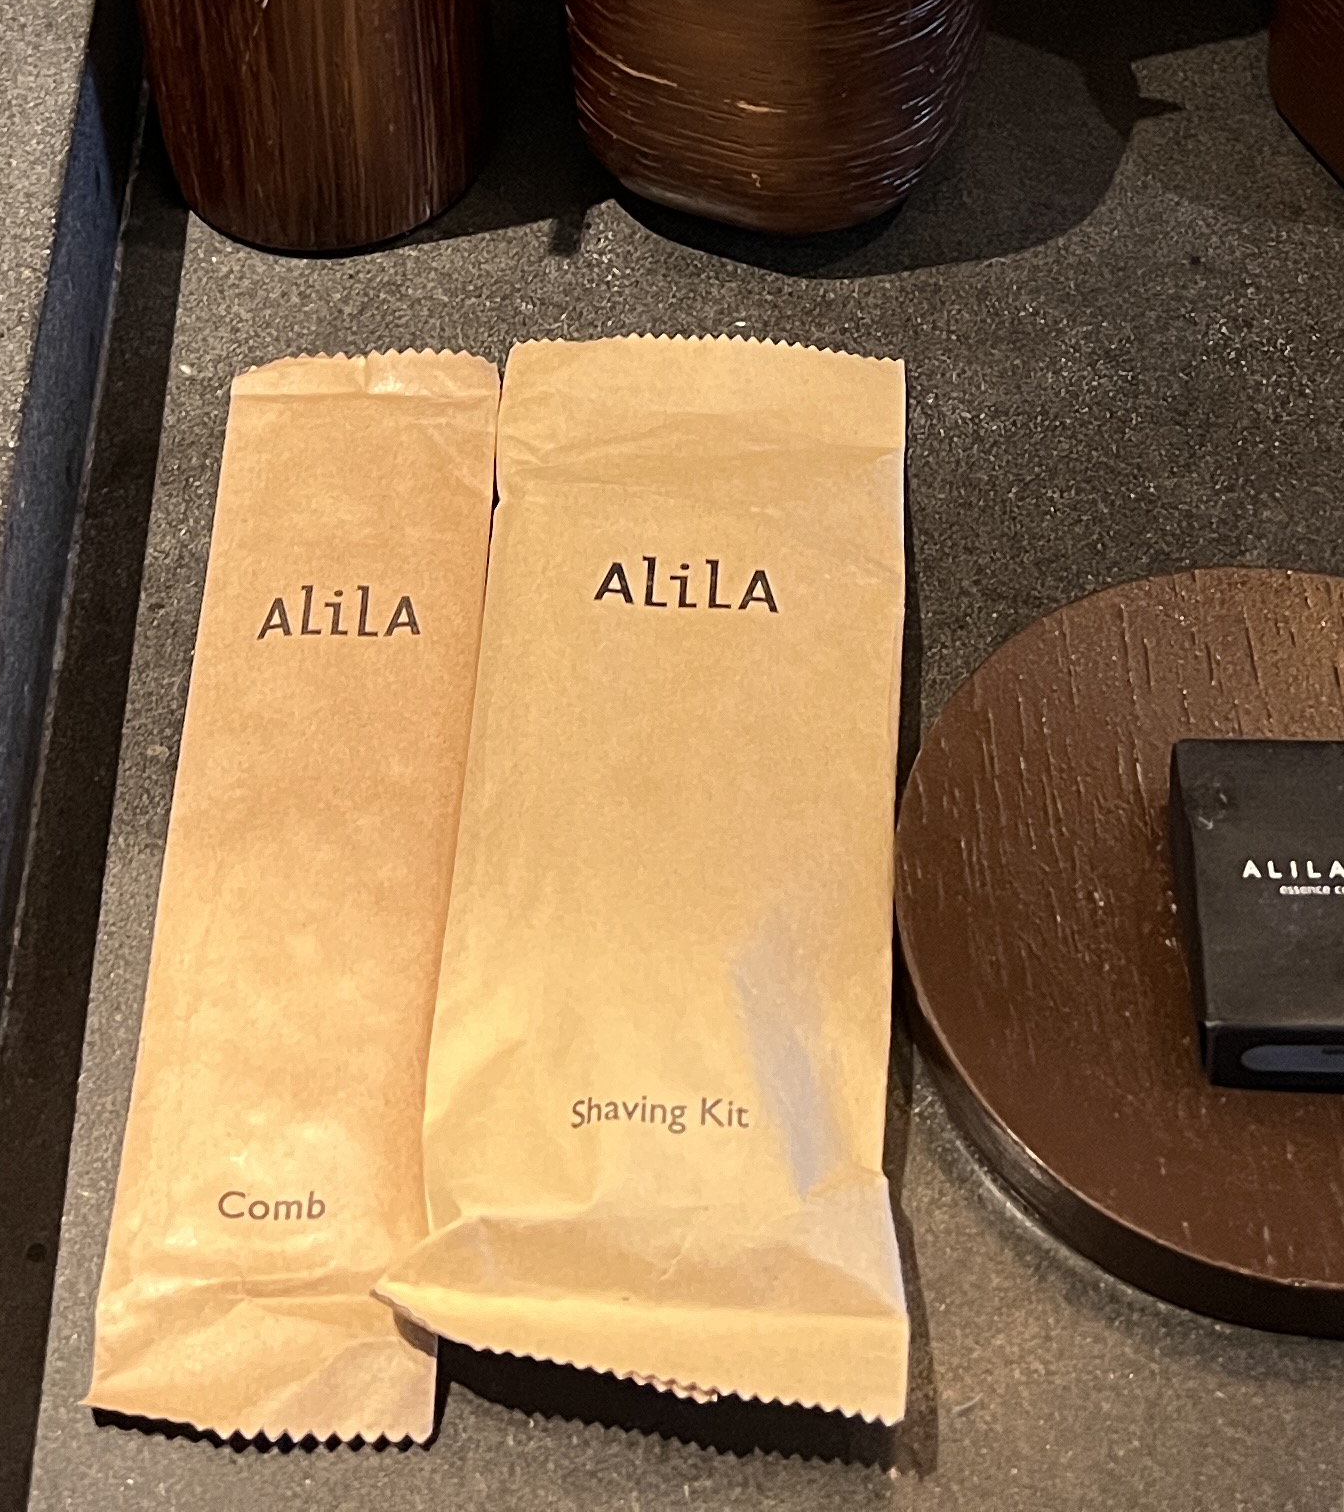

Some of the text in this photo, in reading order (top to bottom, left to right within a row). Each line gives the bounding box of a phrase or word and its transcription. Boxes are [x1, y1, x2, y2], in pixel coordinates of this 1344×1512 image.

[570, 1095, 749, 1134] Shaving Kit
[218, 1190, 326, 1221] Comb
